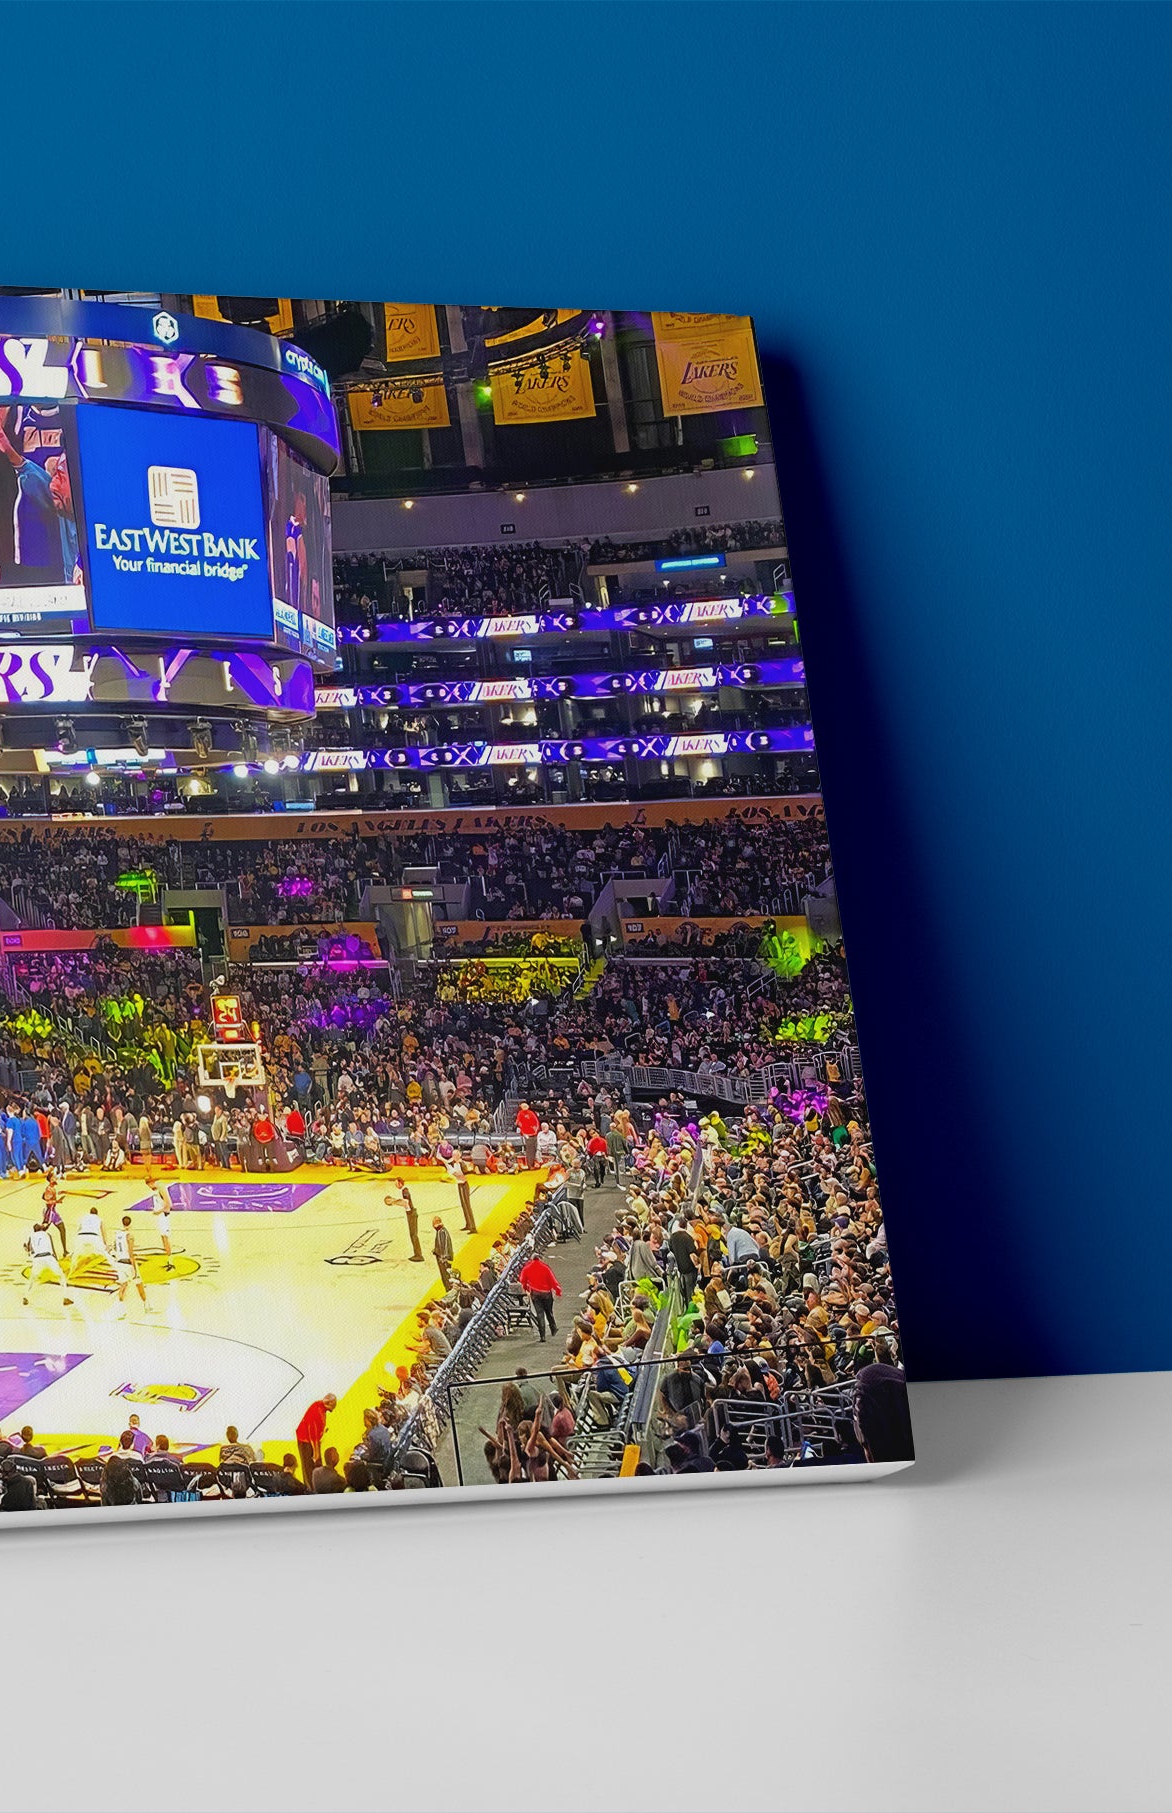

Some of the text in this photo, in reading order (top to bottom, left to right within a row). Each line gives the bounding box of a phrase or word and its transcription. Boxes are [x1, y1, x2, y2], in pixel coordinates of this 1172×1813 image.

[681, 360, 739, 385] LAKERS
[112, 554, 144, 572] Your
[145, 556, 201, 576] financial
[219, 1007, 238, 1023] 24
